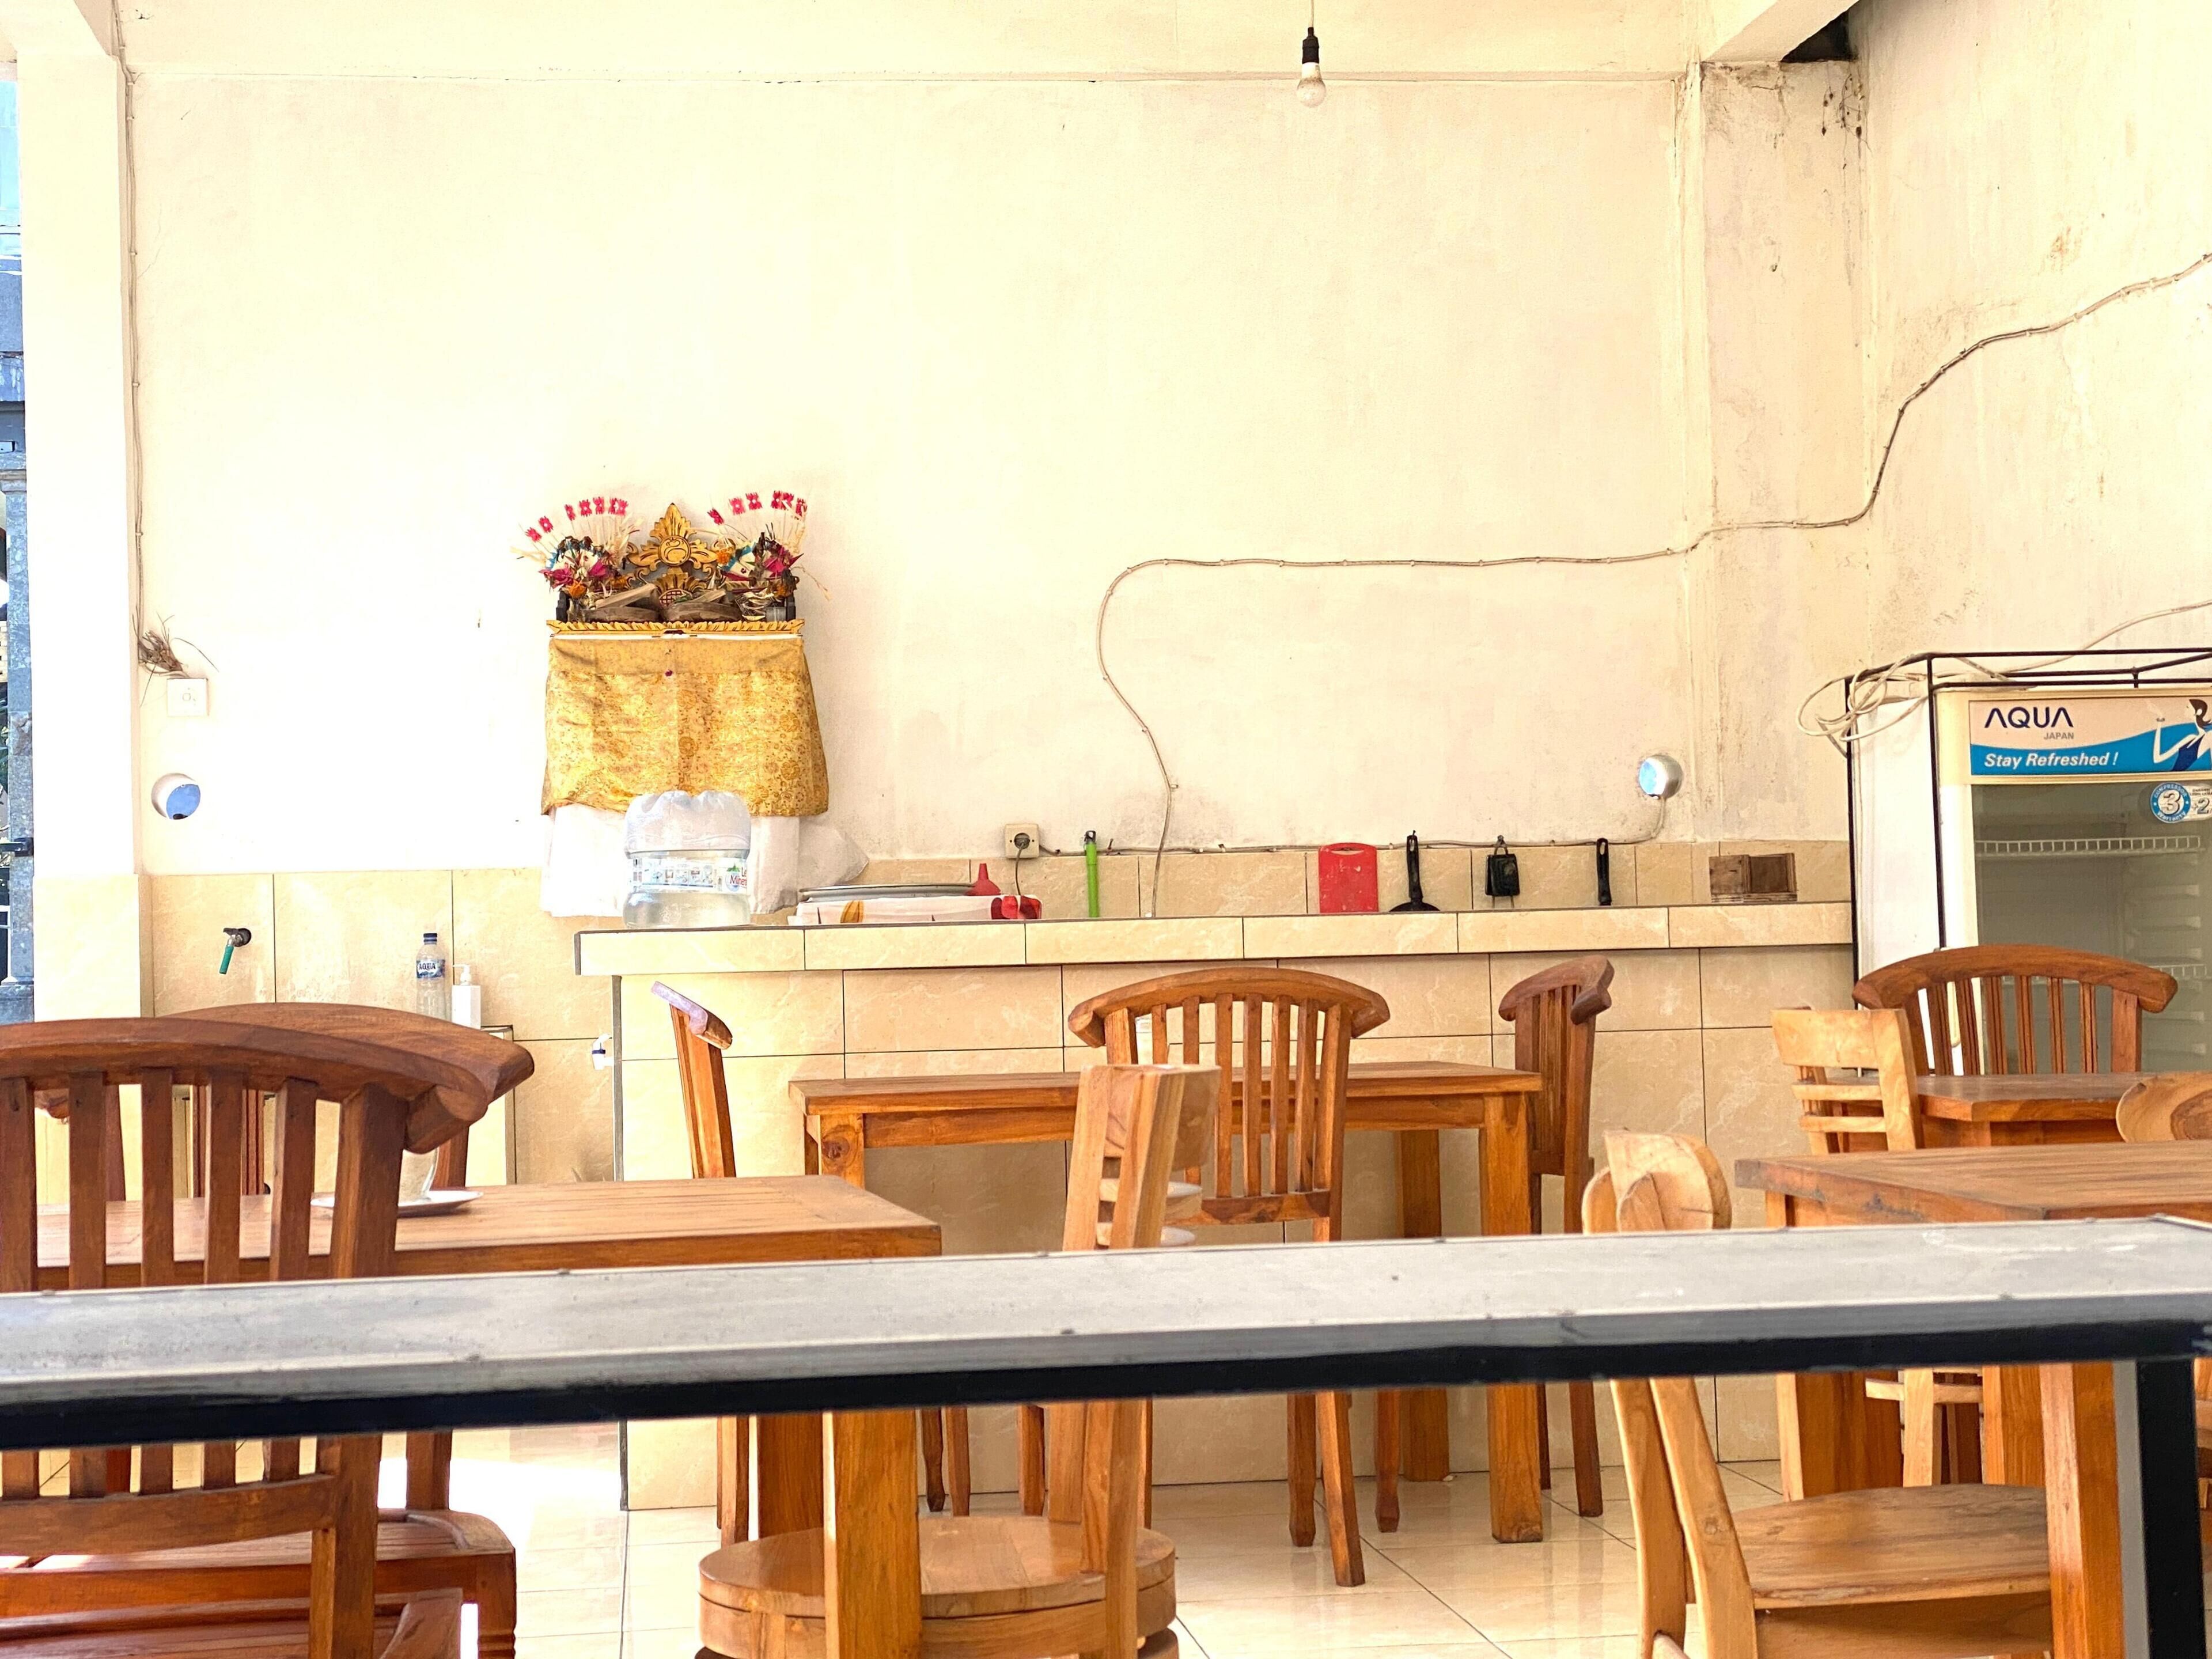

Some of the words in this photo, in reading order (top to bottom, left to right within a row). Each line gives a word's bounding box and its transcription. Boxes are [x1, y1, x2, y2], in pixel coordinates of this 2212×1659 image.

[1984, 706, 2074, 728] AQUA
[1984, 753, 2022, 770] Stay
[2162, 792, 2181, 815] 3
[419, 963, 435, 971] AQUA
